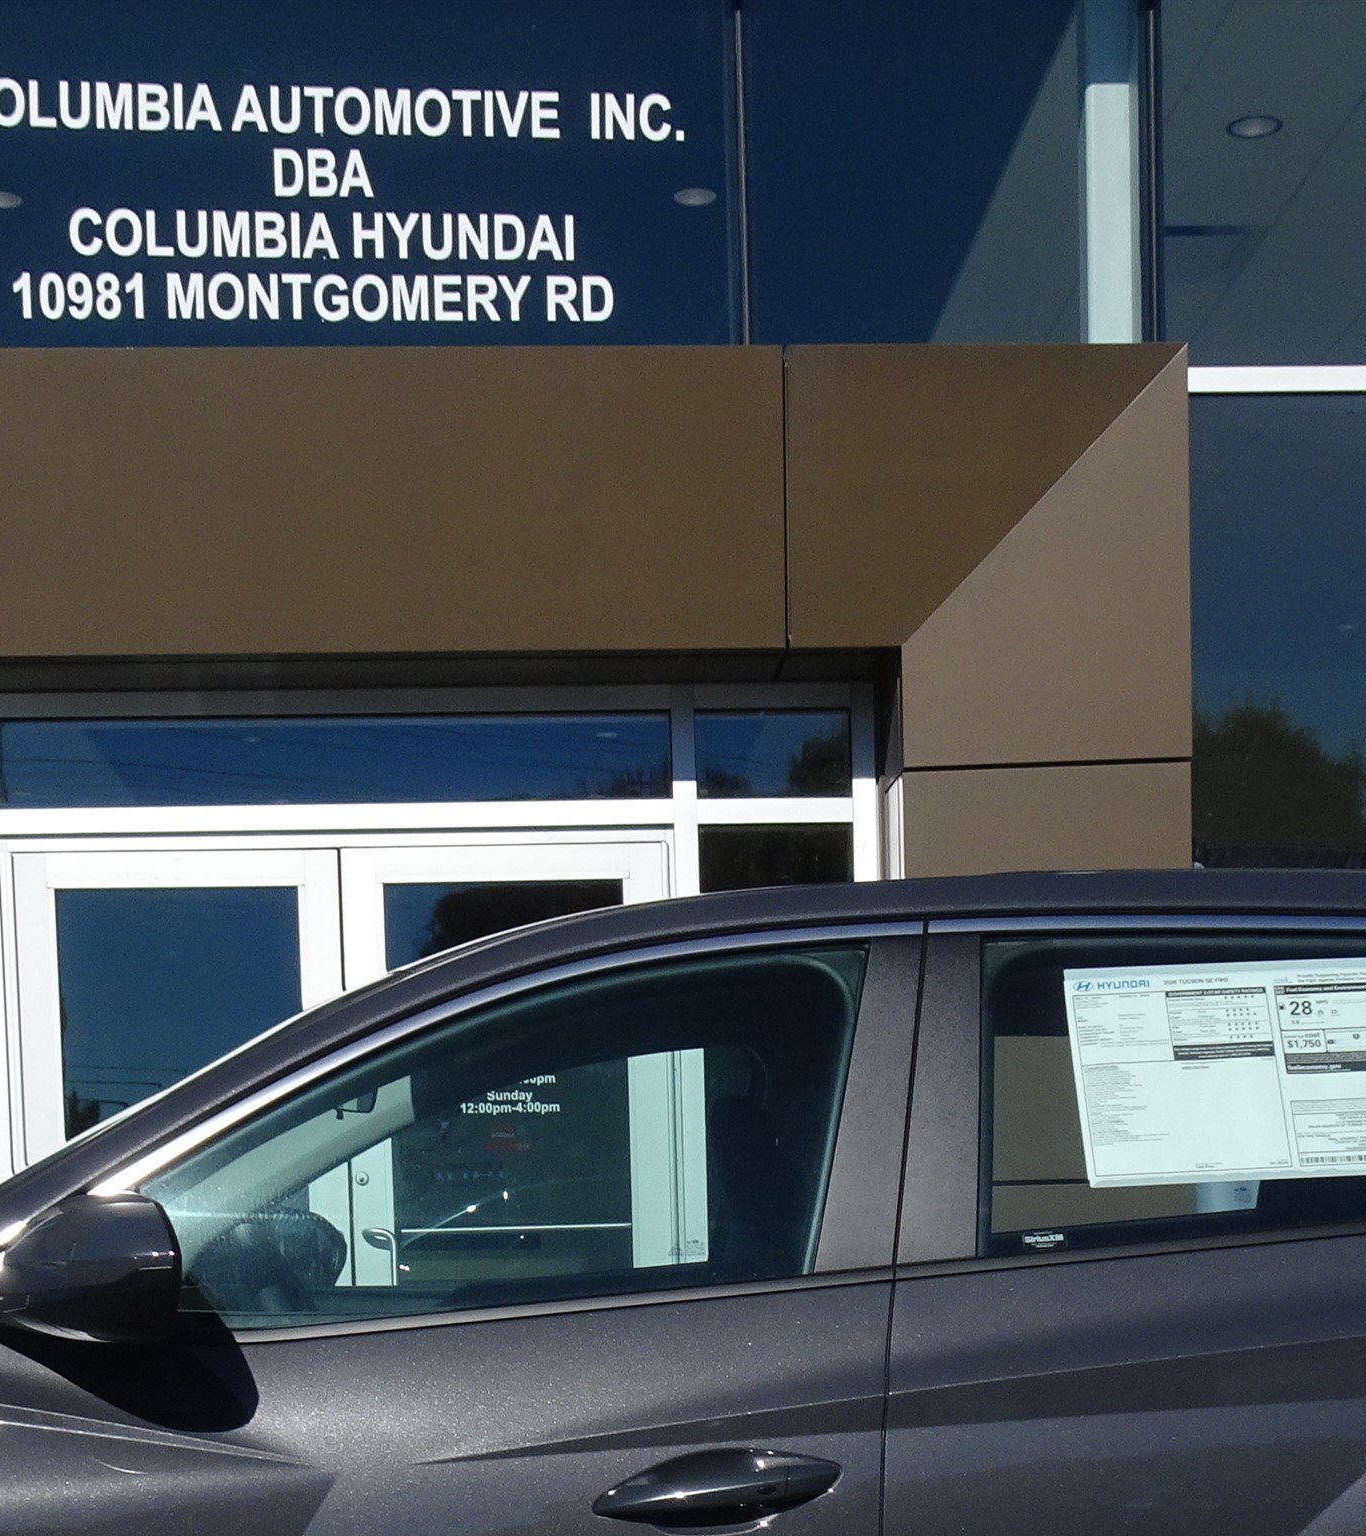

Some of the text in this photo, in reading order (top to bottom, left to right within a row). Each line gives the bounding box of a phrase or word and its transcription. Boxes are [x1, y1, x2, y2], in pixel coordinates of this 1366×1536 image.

[232, 84, 561, 139] AUTOMOTIVE
[590, 92, 686, 143] INC.
[273, 148, 374, 198] DBA
[69, 207, 575, 262] COLUMBIA HYUNDAI
[12, 271, 615, 322] 10981 MONTGOMERY RD
[1097, 979, 1151, 990] HYUNDAI
[1289, 1000, 1313, 1016] 28
[1287, 1038, 1322, 1049] $1,750
[486, 1089, 533, 1103] Sunday
[460, 1101, 561, 1115] 12:00pm-4:00pm
